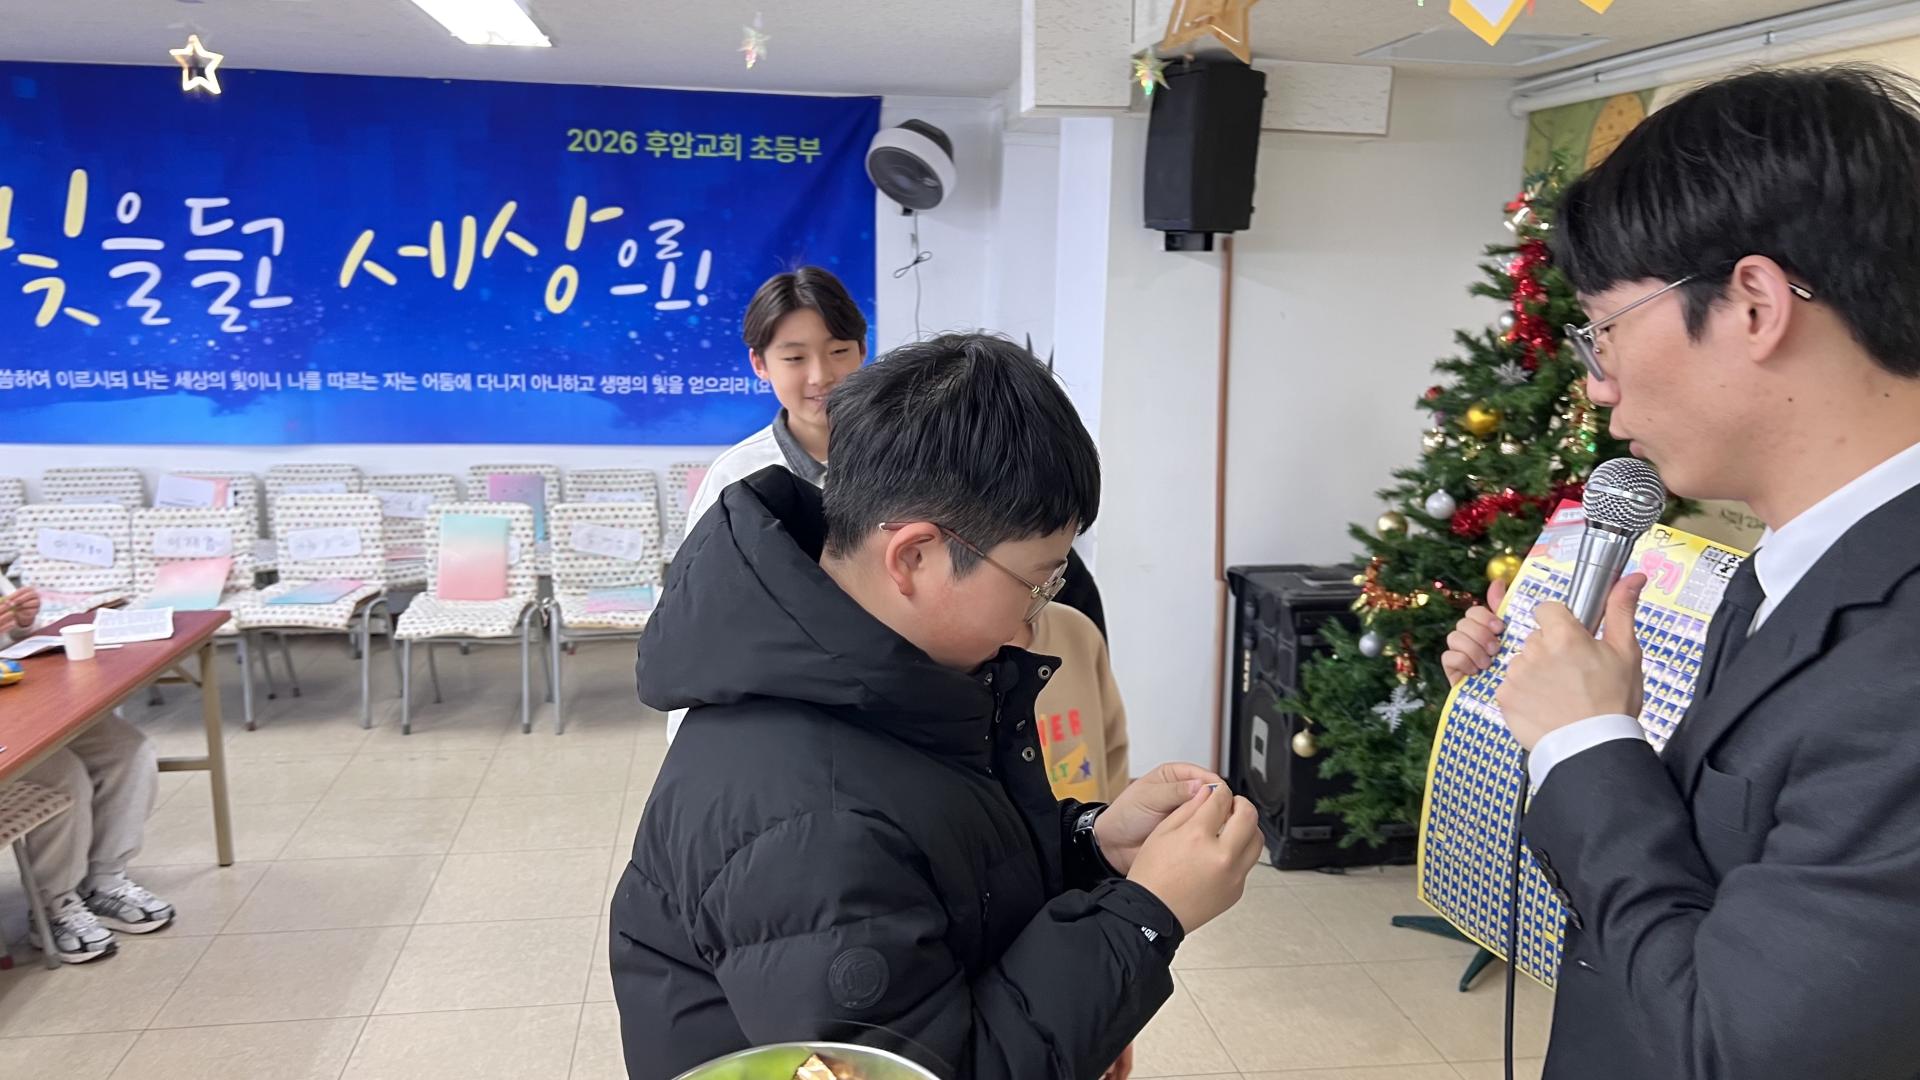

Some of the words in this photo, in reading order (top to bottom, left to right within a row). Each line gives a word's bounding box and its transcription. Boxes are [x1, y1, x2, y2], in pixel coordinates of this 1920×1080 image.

[566, 128, 639, 155] 2026
[645, 130, 742, 161] 후암교회
[748, 135, 823, 164] 초등부
[184, 196, 293, 333] 들고
[339, 195, 712, 315] 세상으로!
[55, 369, 129, 390] 이르시되
[132, 370, 171, 391] 나는
[174, 370, 227, 392] 세상의
[230, 370, 282, 392] 빛이니
[286, 371, 322, 392] 나를
[327, 371, 378, 392] 따르는
[382, 371, 418, 392] 자는
[421, 372, 473, 393] 어둠에
[476, 373, 527, 393] 다니지
[530, 374, 596, 394] 아니하고
[599, 374, 648, 395] 생명의
[652, 374, 685, 396] 빛을
[687, 375, 750, 396] 얻으리라
